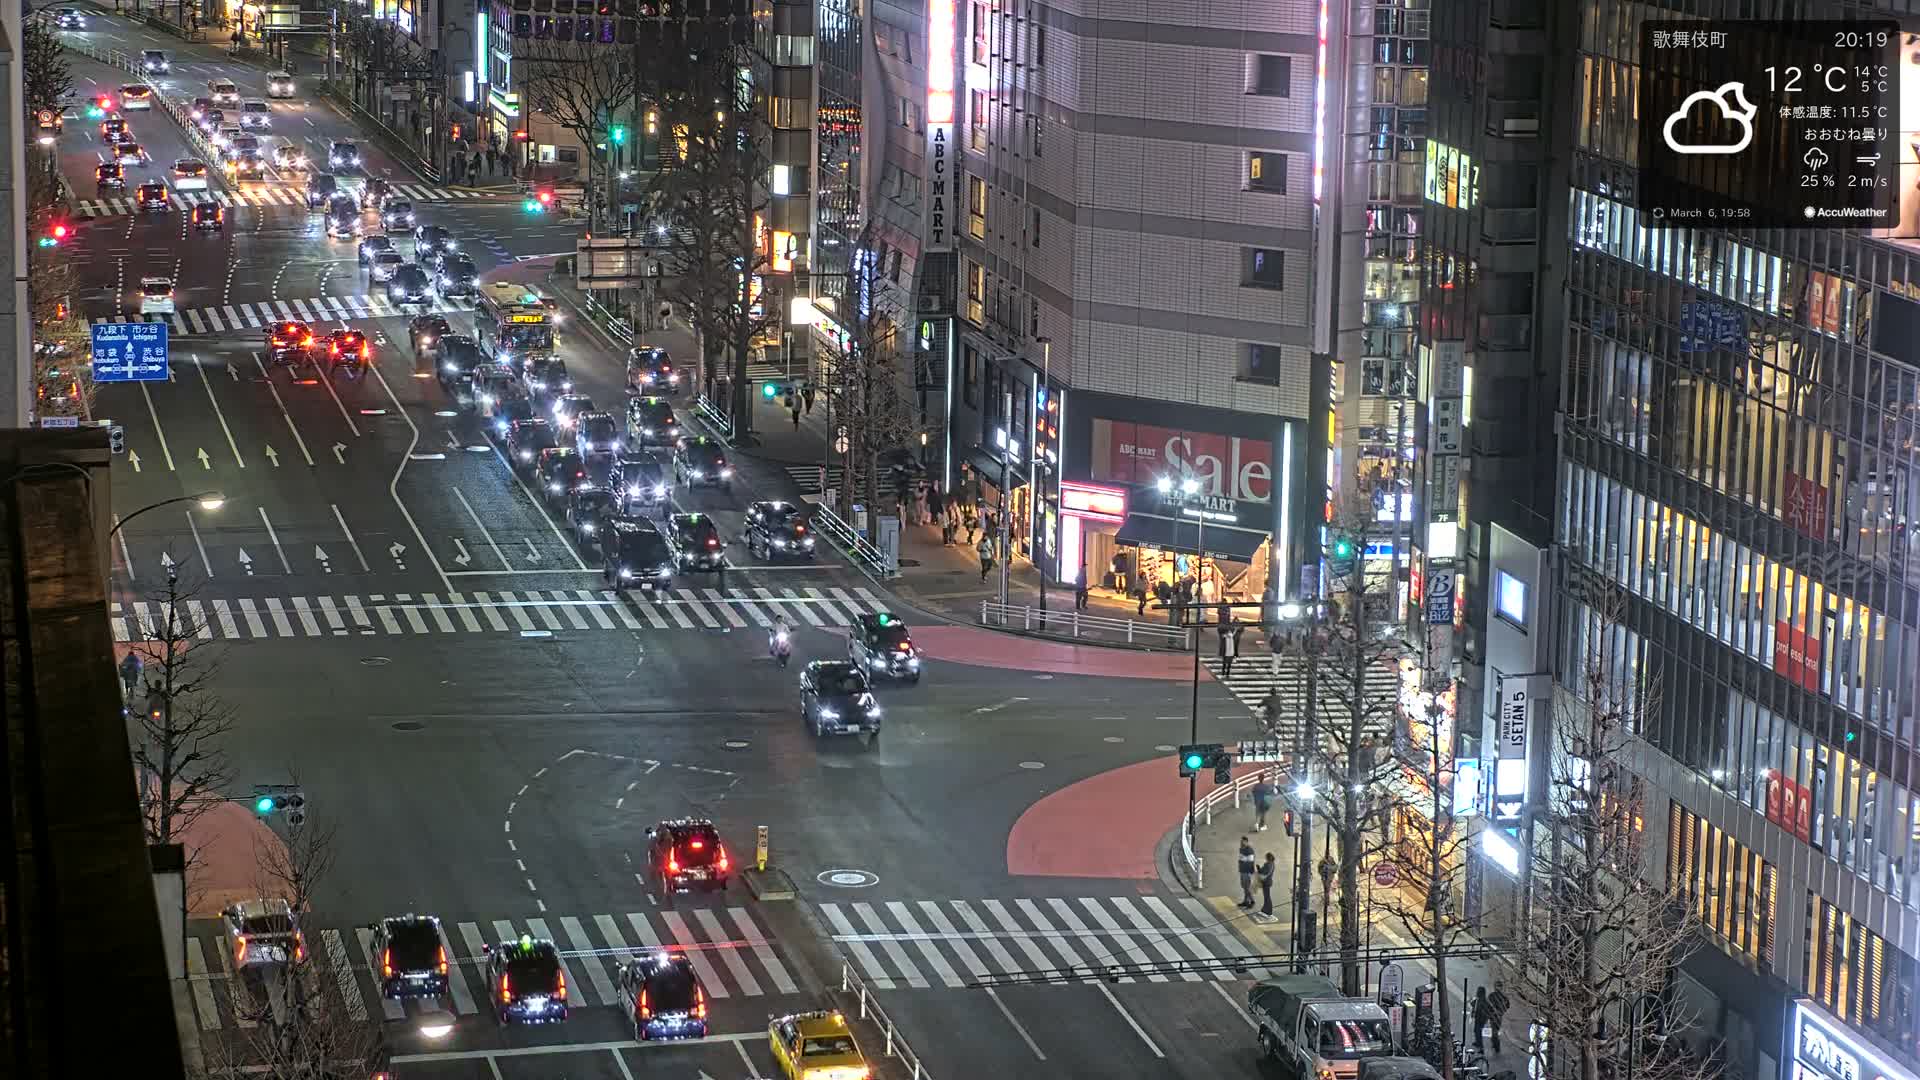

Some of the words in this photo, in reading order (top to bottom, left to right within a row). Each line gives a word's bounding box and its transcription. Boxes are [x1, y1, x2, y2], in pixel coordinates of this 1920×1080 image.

[99, 325, 127, 335] 九段下
[133, 333, 158, 341] Ichigaya
[143, 346, 165, 356] 渋谷
[142, 356, 166, 364] Shibuya
[1164, 435, 1272, 501] Sale
[1513, 691, 1525, 701] 5
[1503, 702, 1511, 719] CITY
[1511, 705, 1525, 746] ISETAN
